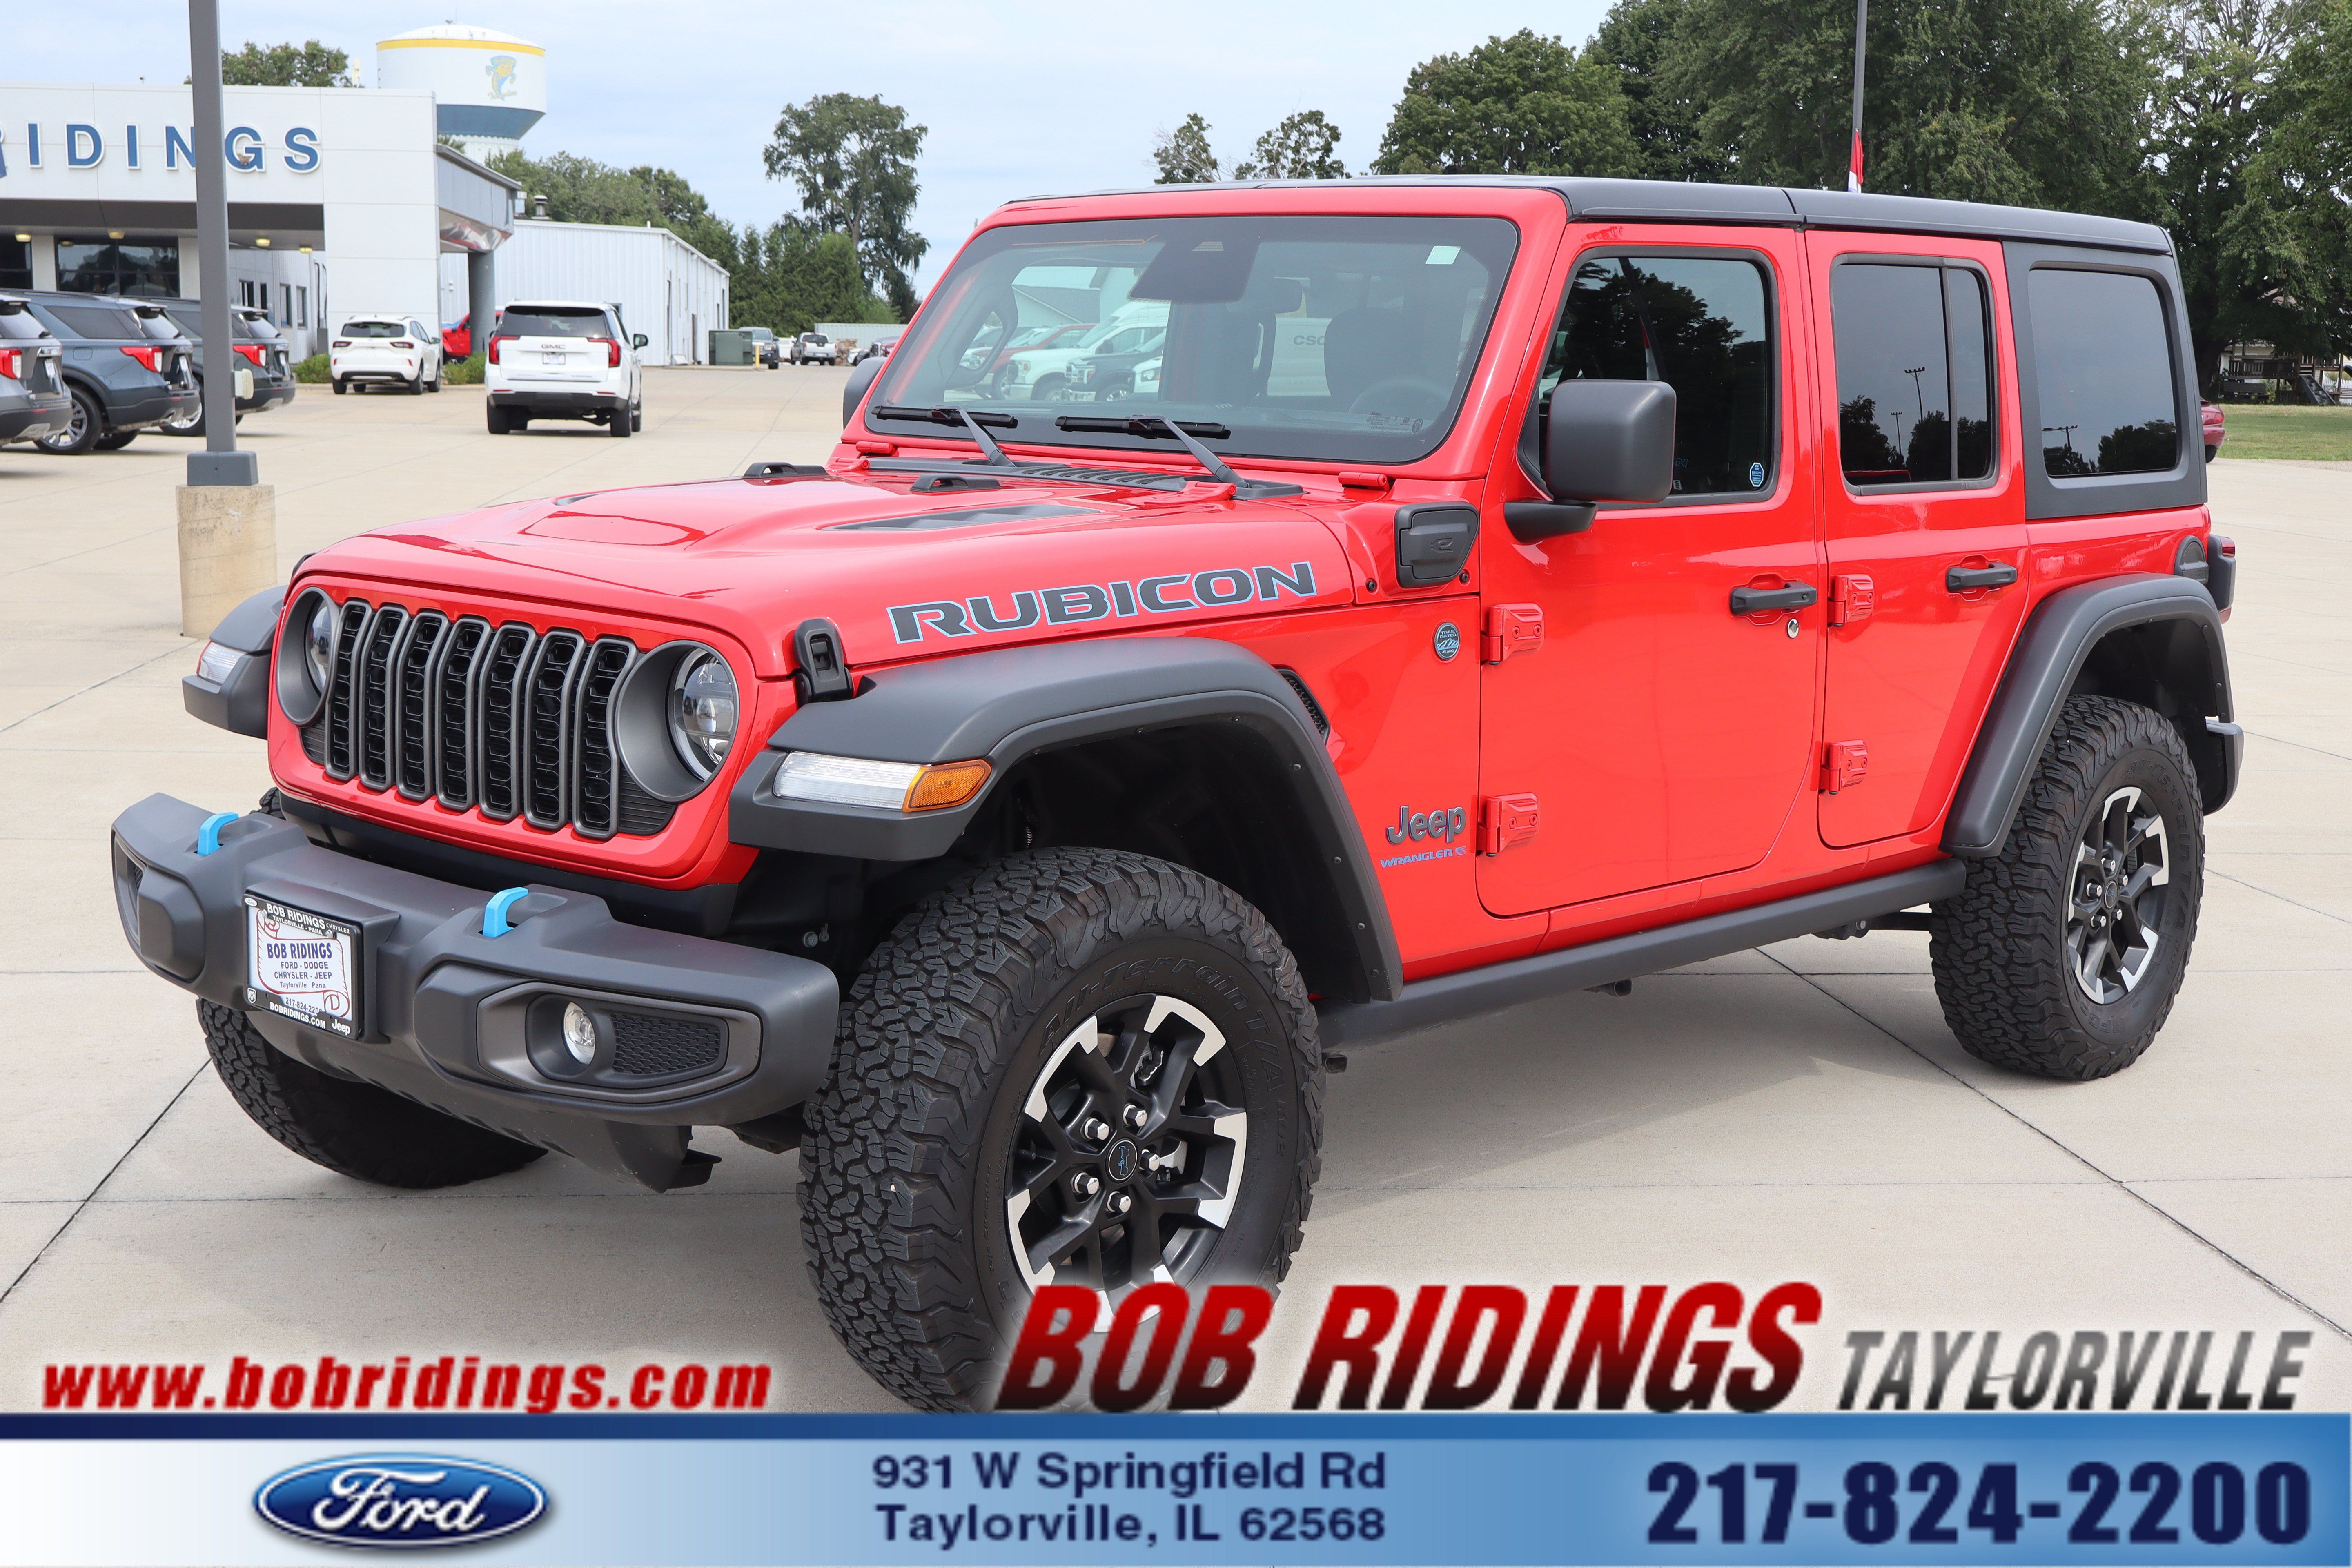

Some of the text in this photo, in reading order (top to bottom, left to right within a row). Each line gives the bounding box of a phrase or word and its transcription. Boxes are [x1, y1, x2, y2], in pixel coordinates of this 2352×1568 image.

[0, 121, 321, 178] IDINGS
[887, 561, 1316, 644] RUBICON
[1386, 805, 1467, 845] Jeep
[1379, 848, 1454, 869] WRANGLER
[266, 903, 326, 930] BOB RIDINGS
[272, 915, 304, 930] TAYLORVILLE
[309, 926, 323, 935] PANA
[326, 923, 350, 934] CHRYSLER
[267, 942, 332, 959] BOB RIDINGS
[279, 981, 307, 989] Taylorville
[270, 1002, 326, 1029] BOBRIDINGS.COM
[332, 1018, 350, 1036] Jeep
